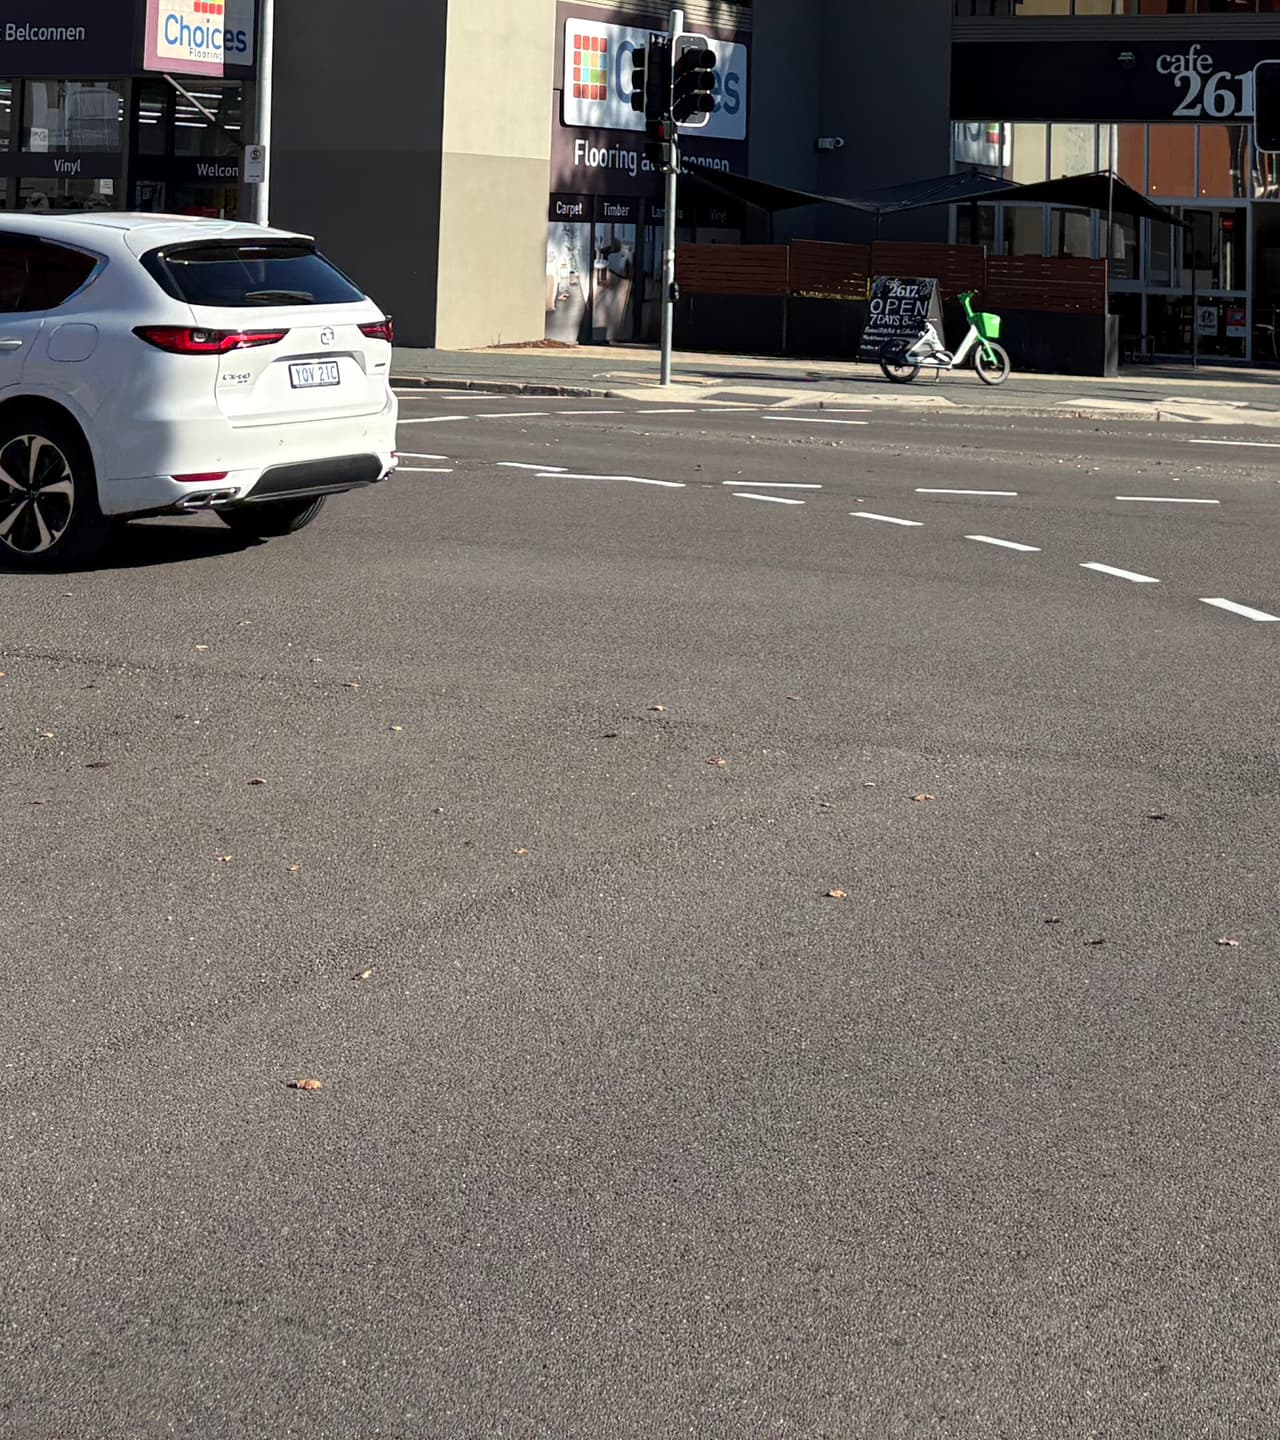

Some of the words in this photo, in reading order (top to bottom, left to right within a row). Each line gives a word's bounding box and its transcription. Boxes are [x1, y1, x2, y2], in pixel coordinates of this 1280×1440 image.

[5, 23, 85, 41] Belconnen
[164, 13, 248, 52] Choices
[1156, 43, 1213, 74] cafe
[1172, 70, 1255, 118] 261
[54, 158, 81, 175] Vinyl
[574, 139, 638, 176] Flooring
[556, 201, 583, 217] Carpet
[603, 202, 630, 217] Timber
[888, 284, 919, 297] 2617.
[870, 298, 928, 316] OPEN
[869, 314, 878, 325] 7
[877, 314, 900, 326] DAYS
[318, 364, 338, 382] 21C
